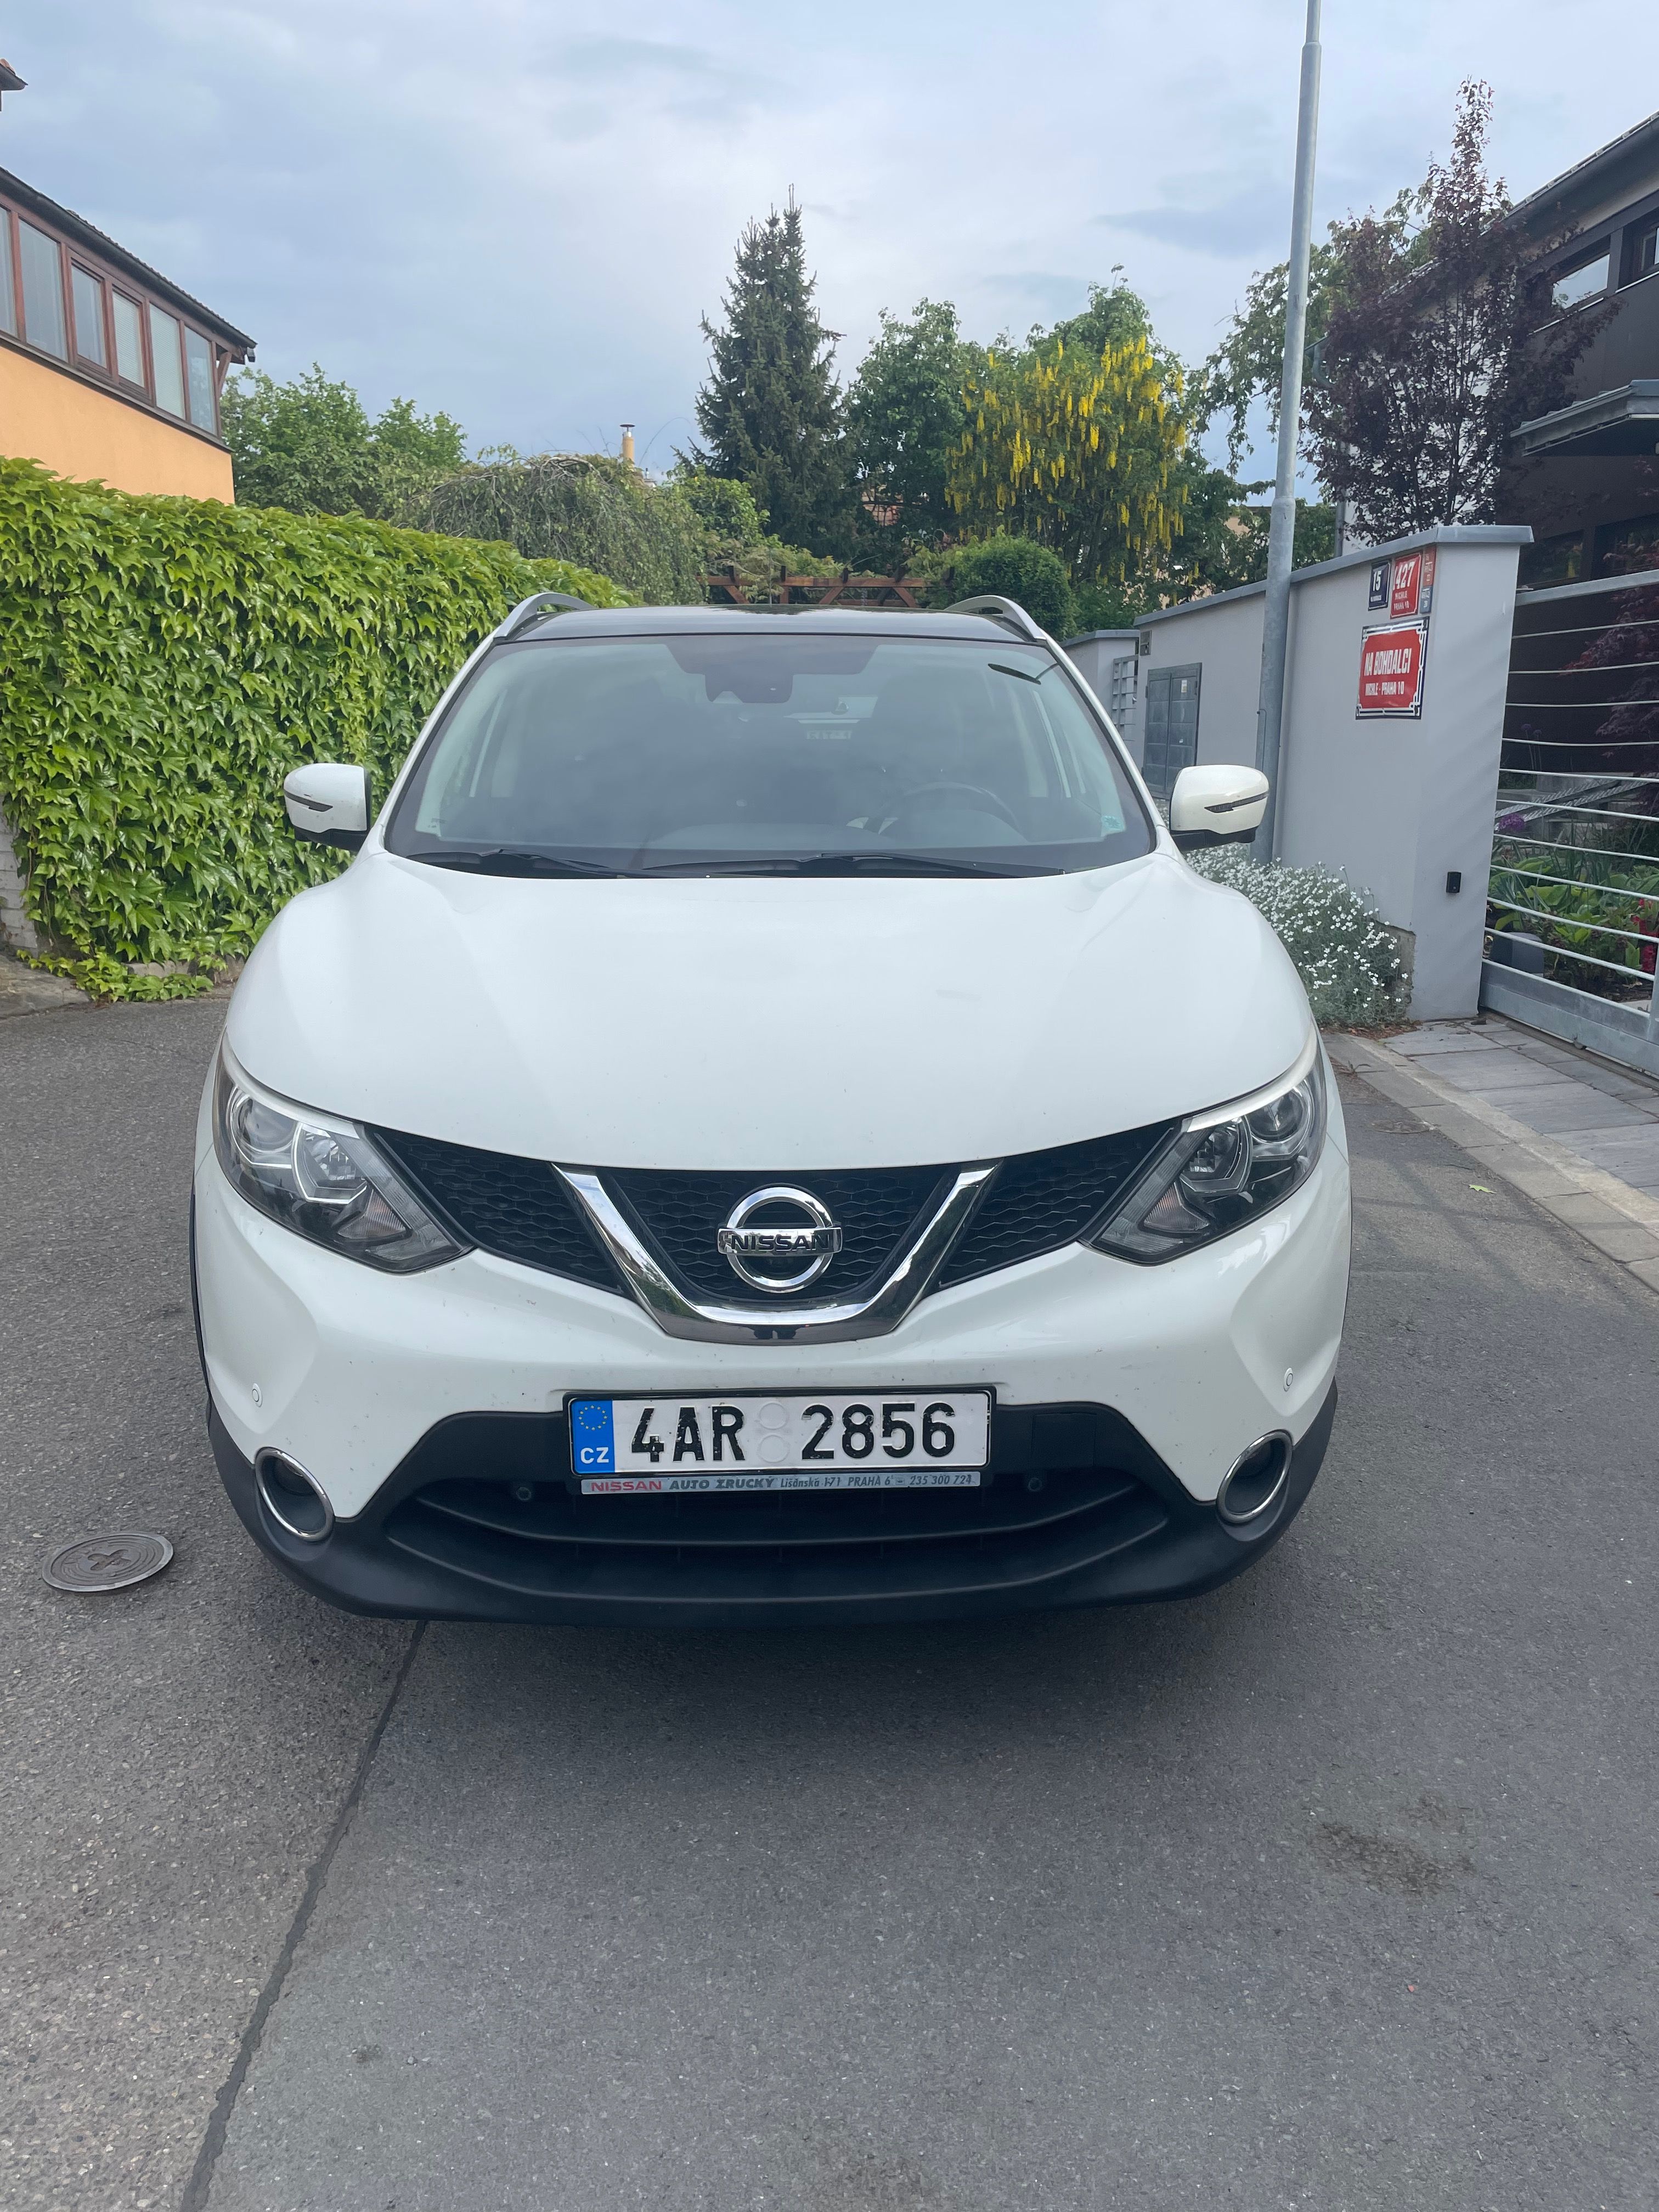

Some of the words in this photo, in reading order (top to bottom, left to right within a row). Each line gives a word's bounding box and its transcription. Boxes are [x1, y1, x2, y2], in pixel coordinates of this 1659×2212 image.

[1373, 571, 1382, 591] 15
[1393, 561, 1415, 590] 1427
[1364, 652, 1374, 676] NA
[1373, 648, 1412, 675] BOHDALCI
[1398, 681, 1404, 695] 10
[731, 1234, 830, 1251] NISSAN
[631, 1404, 746, 1462] 4AR
[801, 1401, 956, 1460] 2856
[580, 1447, 610, 1464] CZ
[591, 1481, 662, 1492] NISSAN
[669, 1480, 710, 1489] AUTO
[848, 1475, 881, 1486] PRAHA
[910, 1475, 928, 1485] 235
[931, 1475, 950, 1485] 300
